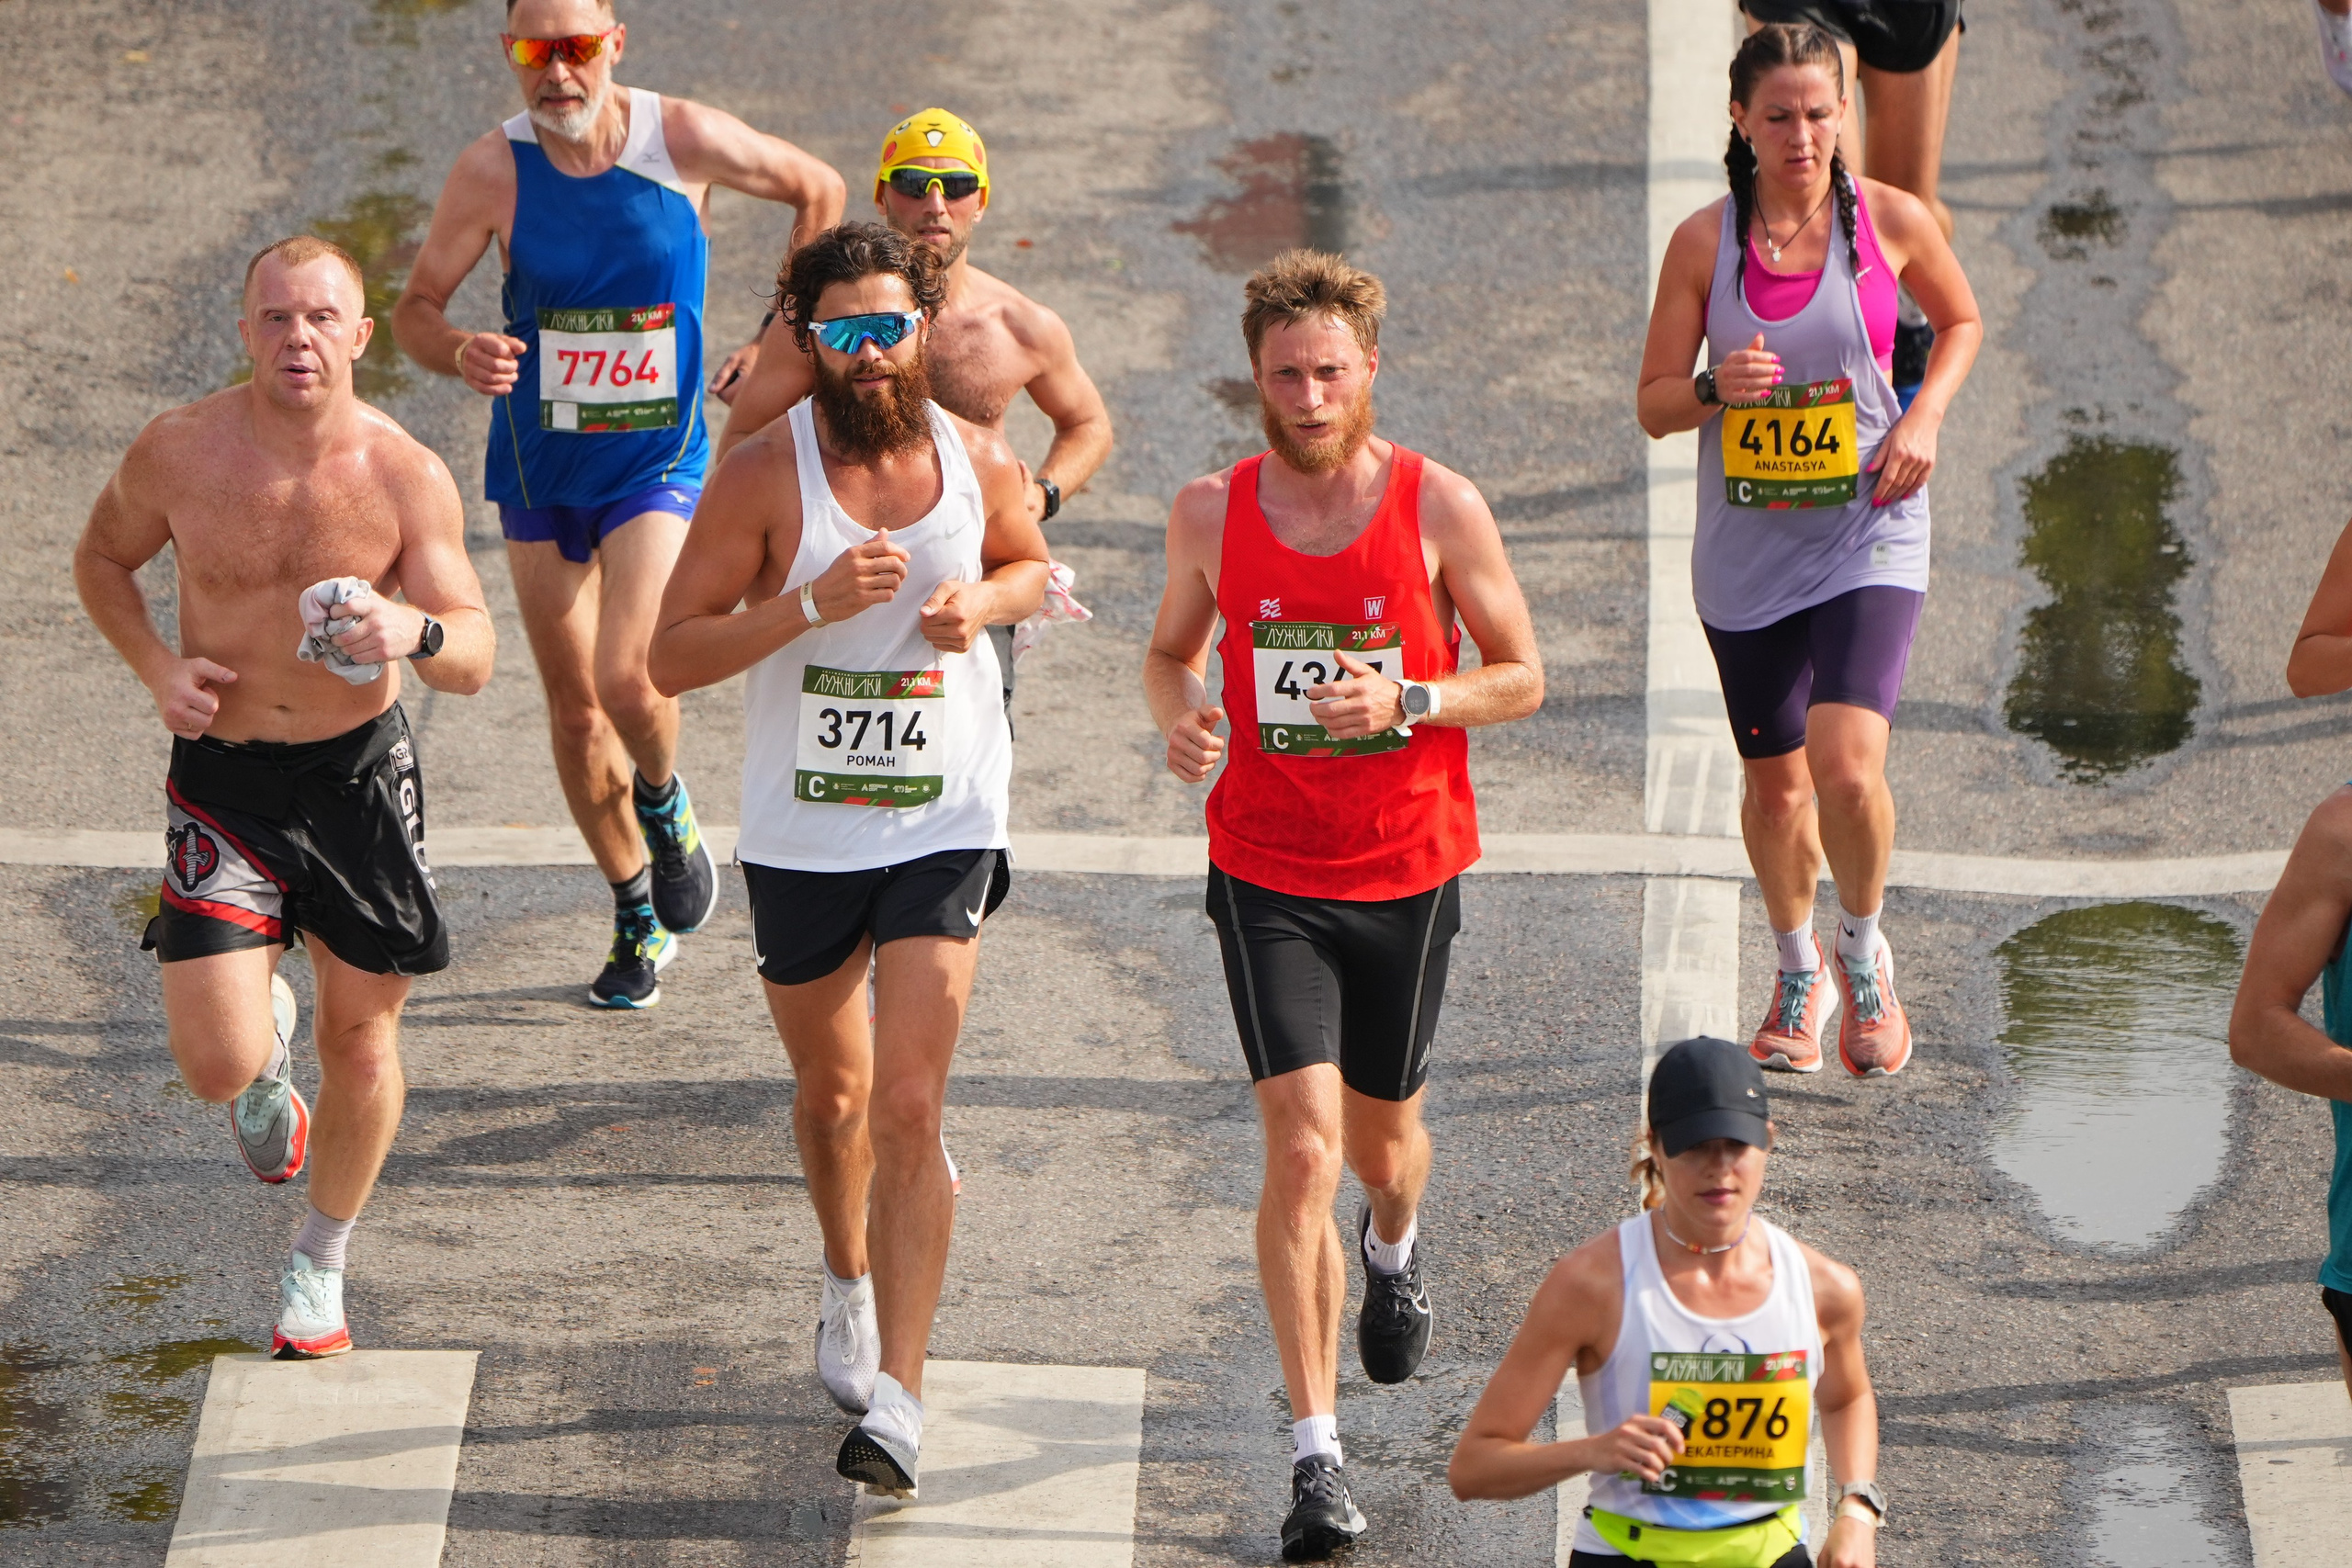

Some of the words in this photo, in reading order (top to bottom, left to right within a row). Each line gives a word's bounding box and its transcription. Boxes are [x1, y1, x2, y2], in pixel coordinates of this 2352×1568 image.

[550, 312, 615, 331] ЛУЖНИКИ
[557, 348, 659, 387] 7764
[1739, 417, 1840, 457] 4164
[1755, 460, 1826, 472] ANASTASYA
[1265, 628, 1334, 648] ЛУЖНИКИ
[1351, 630, 1368, 640] 21,1
[813, 673, 881, 696] ЛУЖНИКИ
[900, 677, 915, 688] 21,1
[818, 707, 927, 751] 3714
[846, 755, 896, 768] РОМАН
[1683, 1396, 1790, 1441] 876
[1685, 1446, 1776, 1460] ЕКАТЕРИНА
